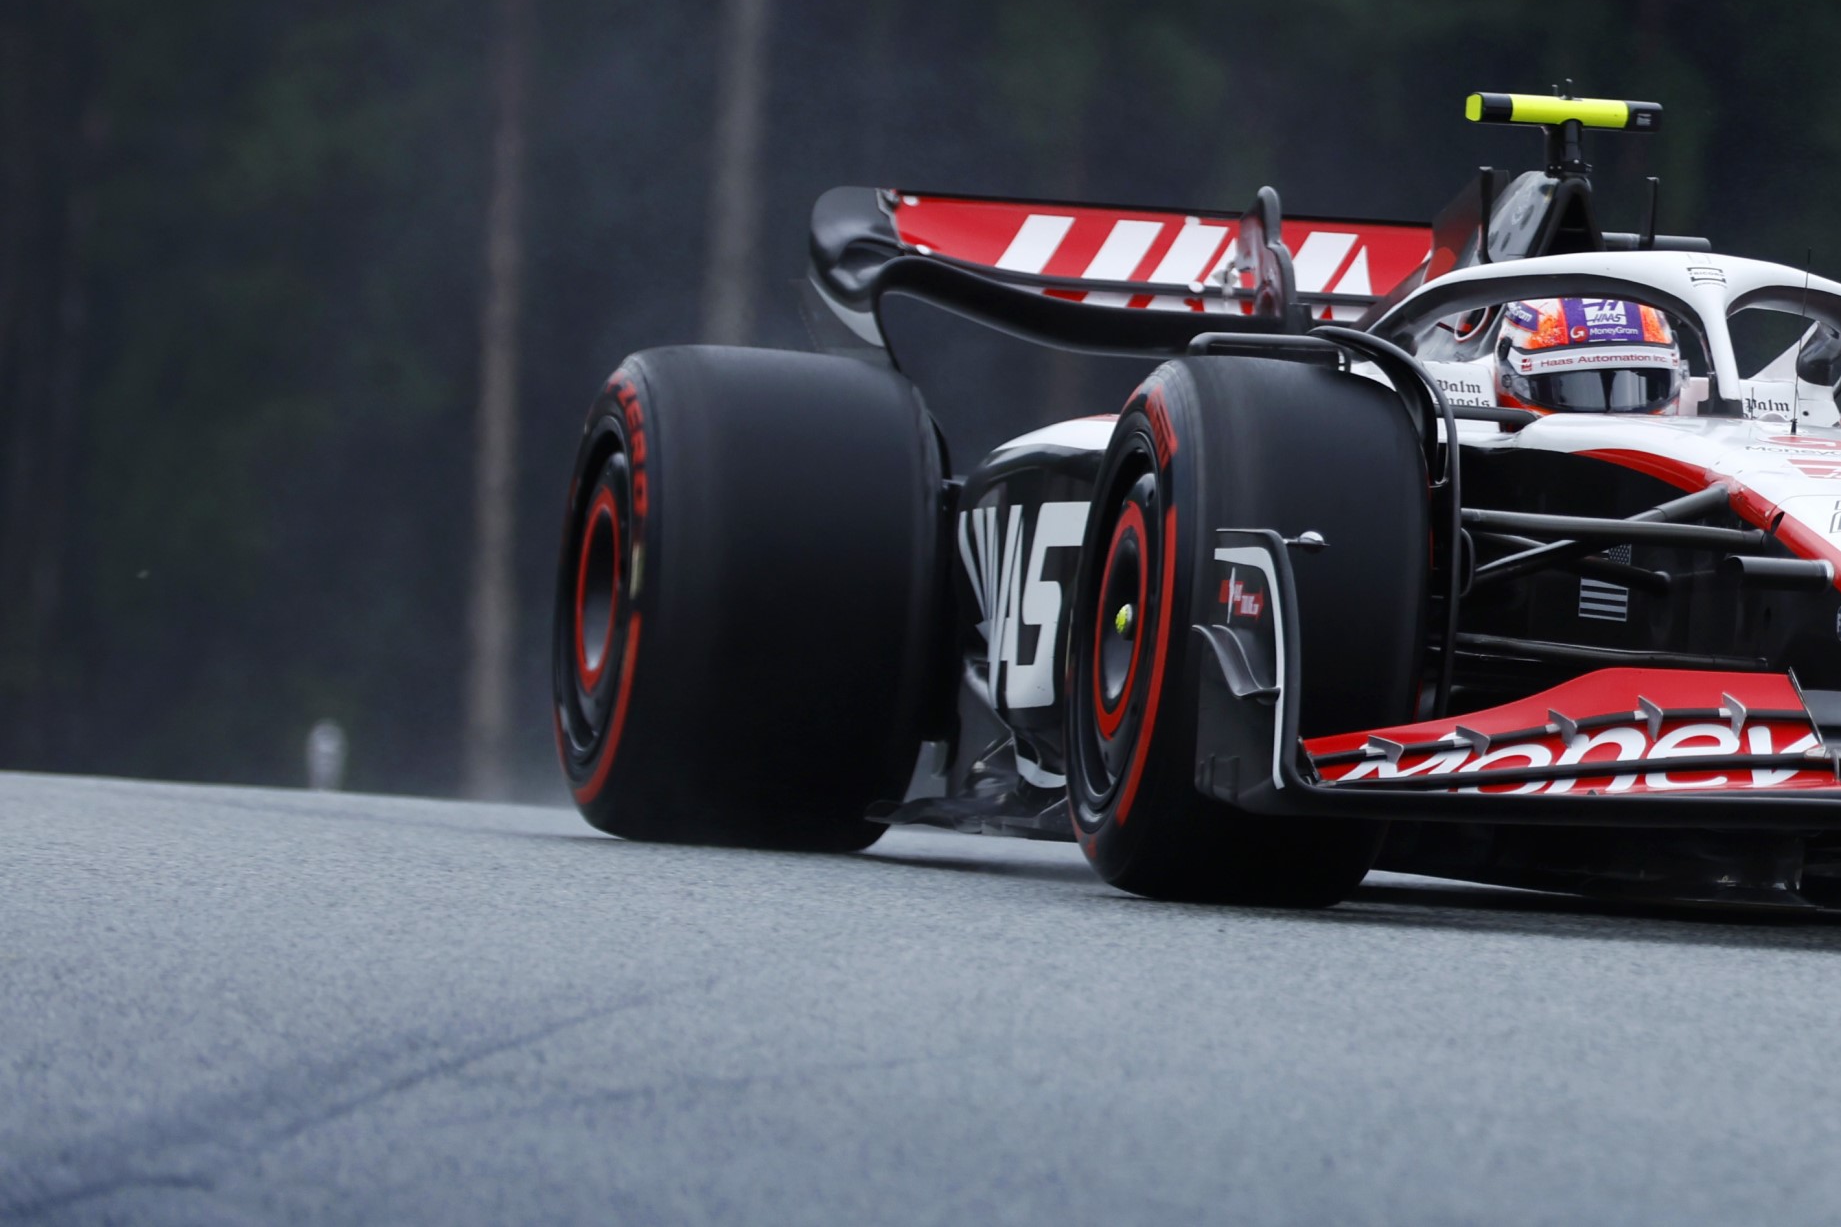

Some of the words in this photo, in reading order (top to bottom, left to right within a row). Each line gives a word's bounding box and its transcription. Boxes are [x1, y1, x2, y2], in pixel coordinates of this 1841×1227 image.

[1589, 327, 1638, 336] MoneyGram
[1541, 358, 1573, 367] Haas
[1577, 354, 1651, 364] Automation
[1653, 355, 1668, 363] Inc.
